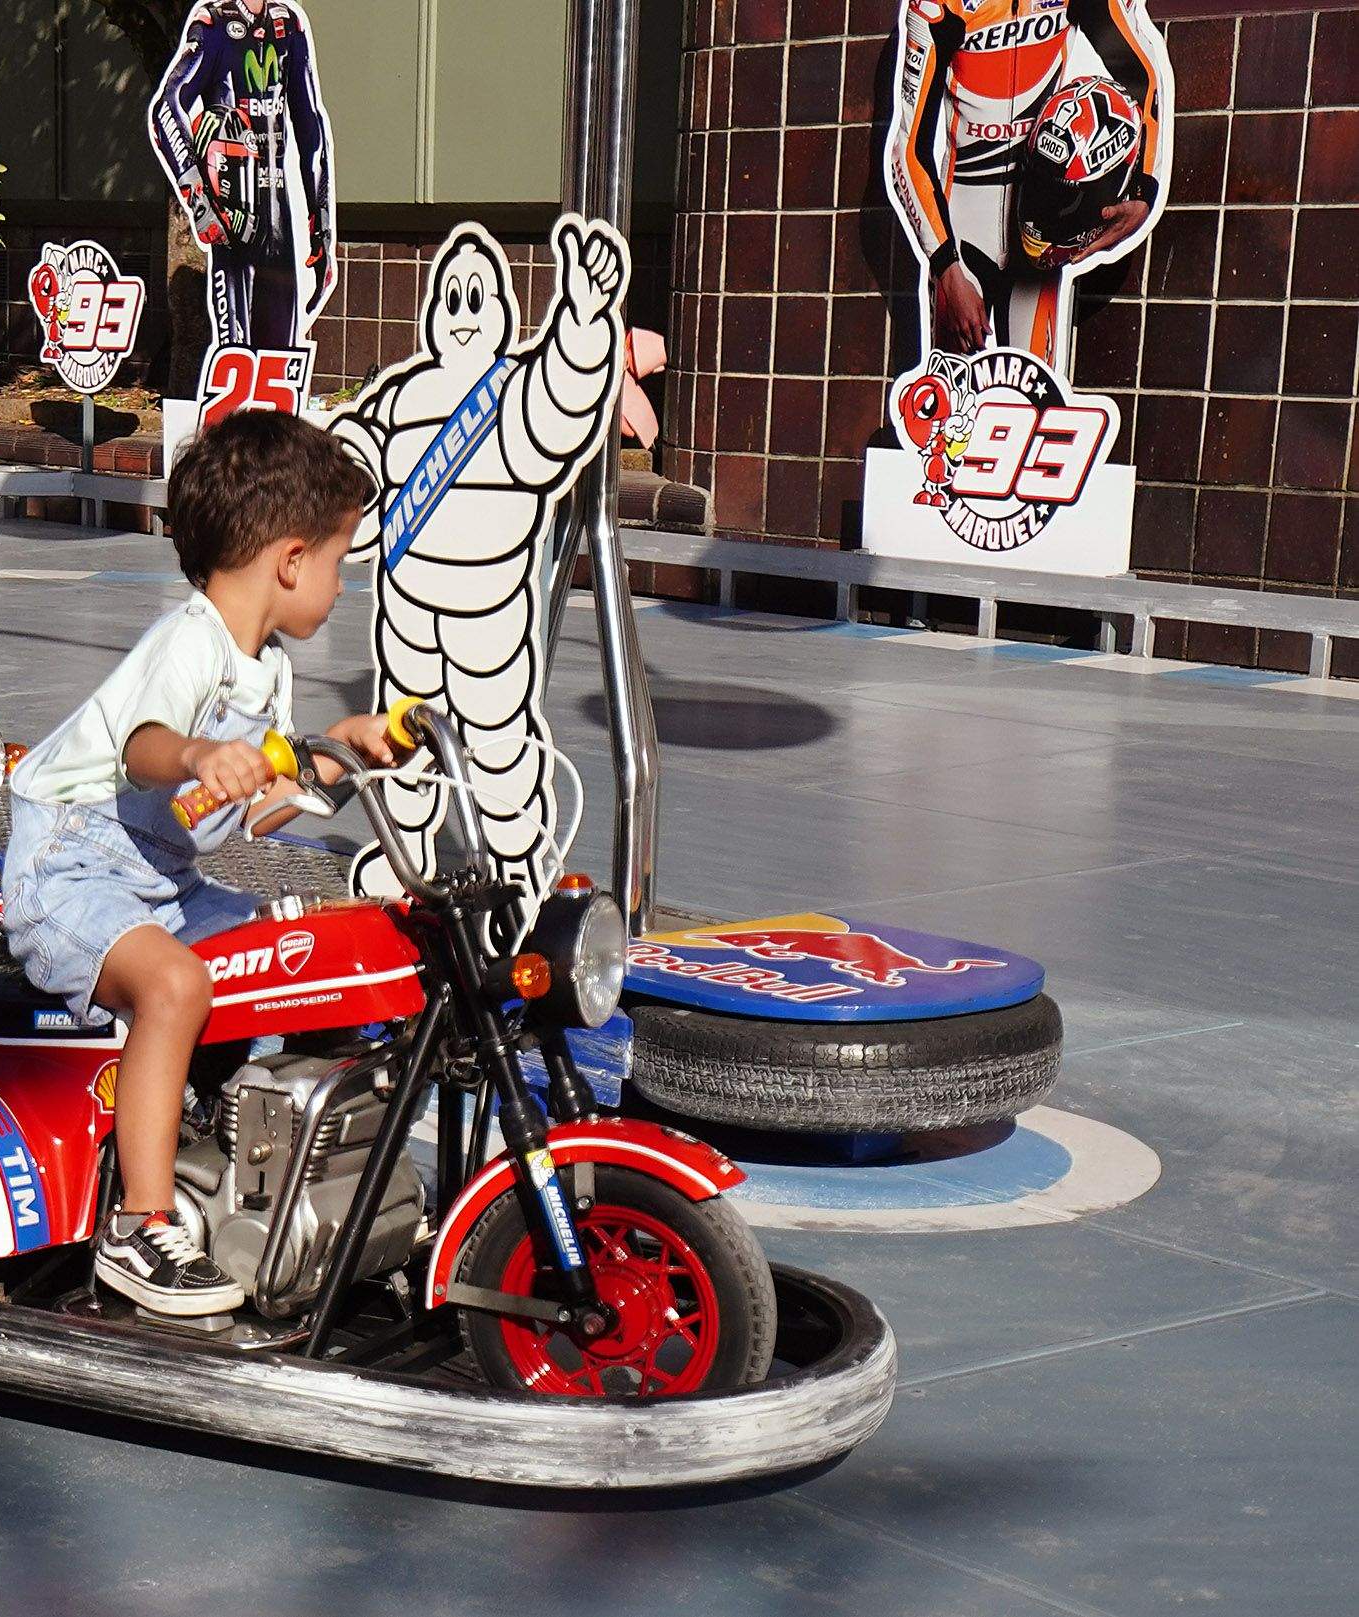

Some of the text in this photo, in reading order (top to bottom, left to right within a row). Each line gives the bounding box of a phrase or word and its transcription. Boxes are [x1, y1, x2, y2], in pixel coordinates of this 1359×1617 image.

[964, 12, 1066, 50] REPSOL
[158, 100, 189, 174] YAMAHA
[965, 117, 1037, 141] HOND
[1041, 134, 1065, 160] SHOEI
[1087, 125, 1130, 168] LOTUS
[894, 159, 923, 231] HONDA
[68, 248, 103, 274] MARC
[62, 281, 142, 352] 93
[214, 269, 230, 346] movi
[61, 354, 113, 388] MARQUEZ
[203, 352, 294, 427] 25
[973, 356, 1038, 392] MARC
[383, 358, 519, 560] MICHELIN
[950, 402, 1110, 506] 93
[945, 500, 1043, 550] MARQUEZ
[203, 947, 275, 984] CATI
[281, 937, 312, 950] DUCATI
[626, 944, 864, 1003] Red Bull
[251, 992, 343, 1013] DESMOSEDICI
[2, 1146, 40, 1228] TIM
[546, 1184, 584, 1268] MICHELIN
